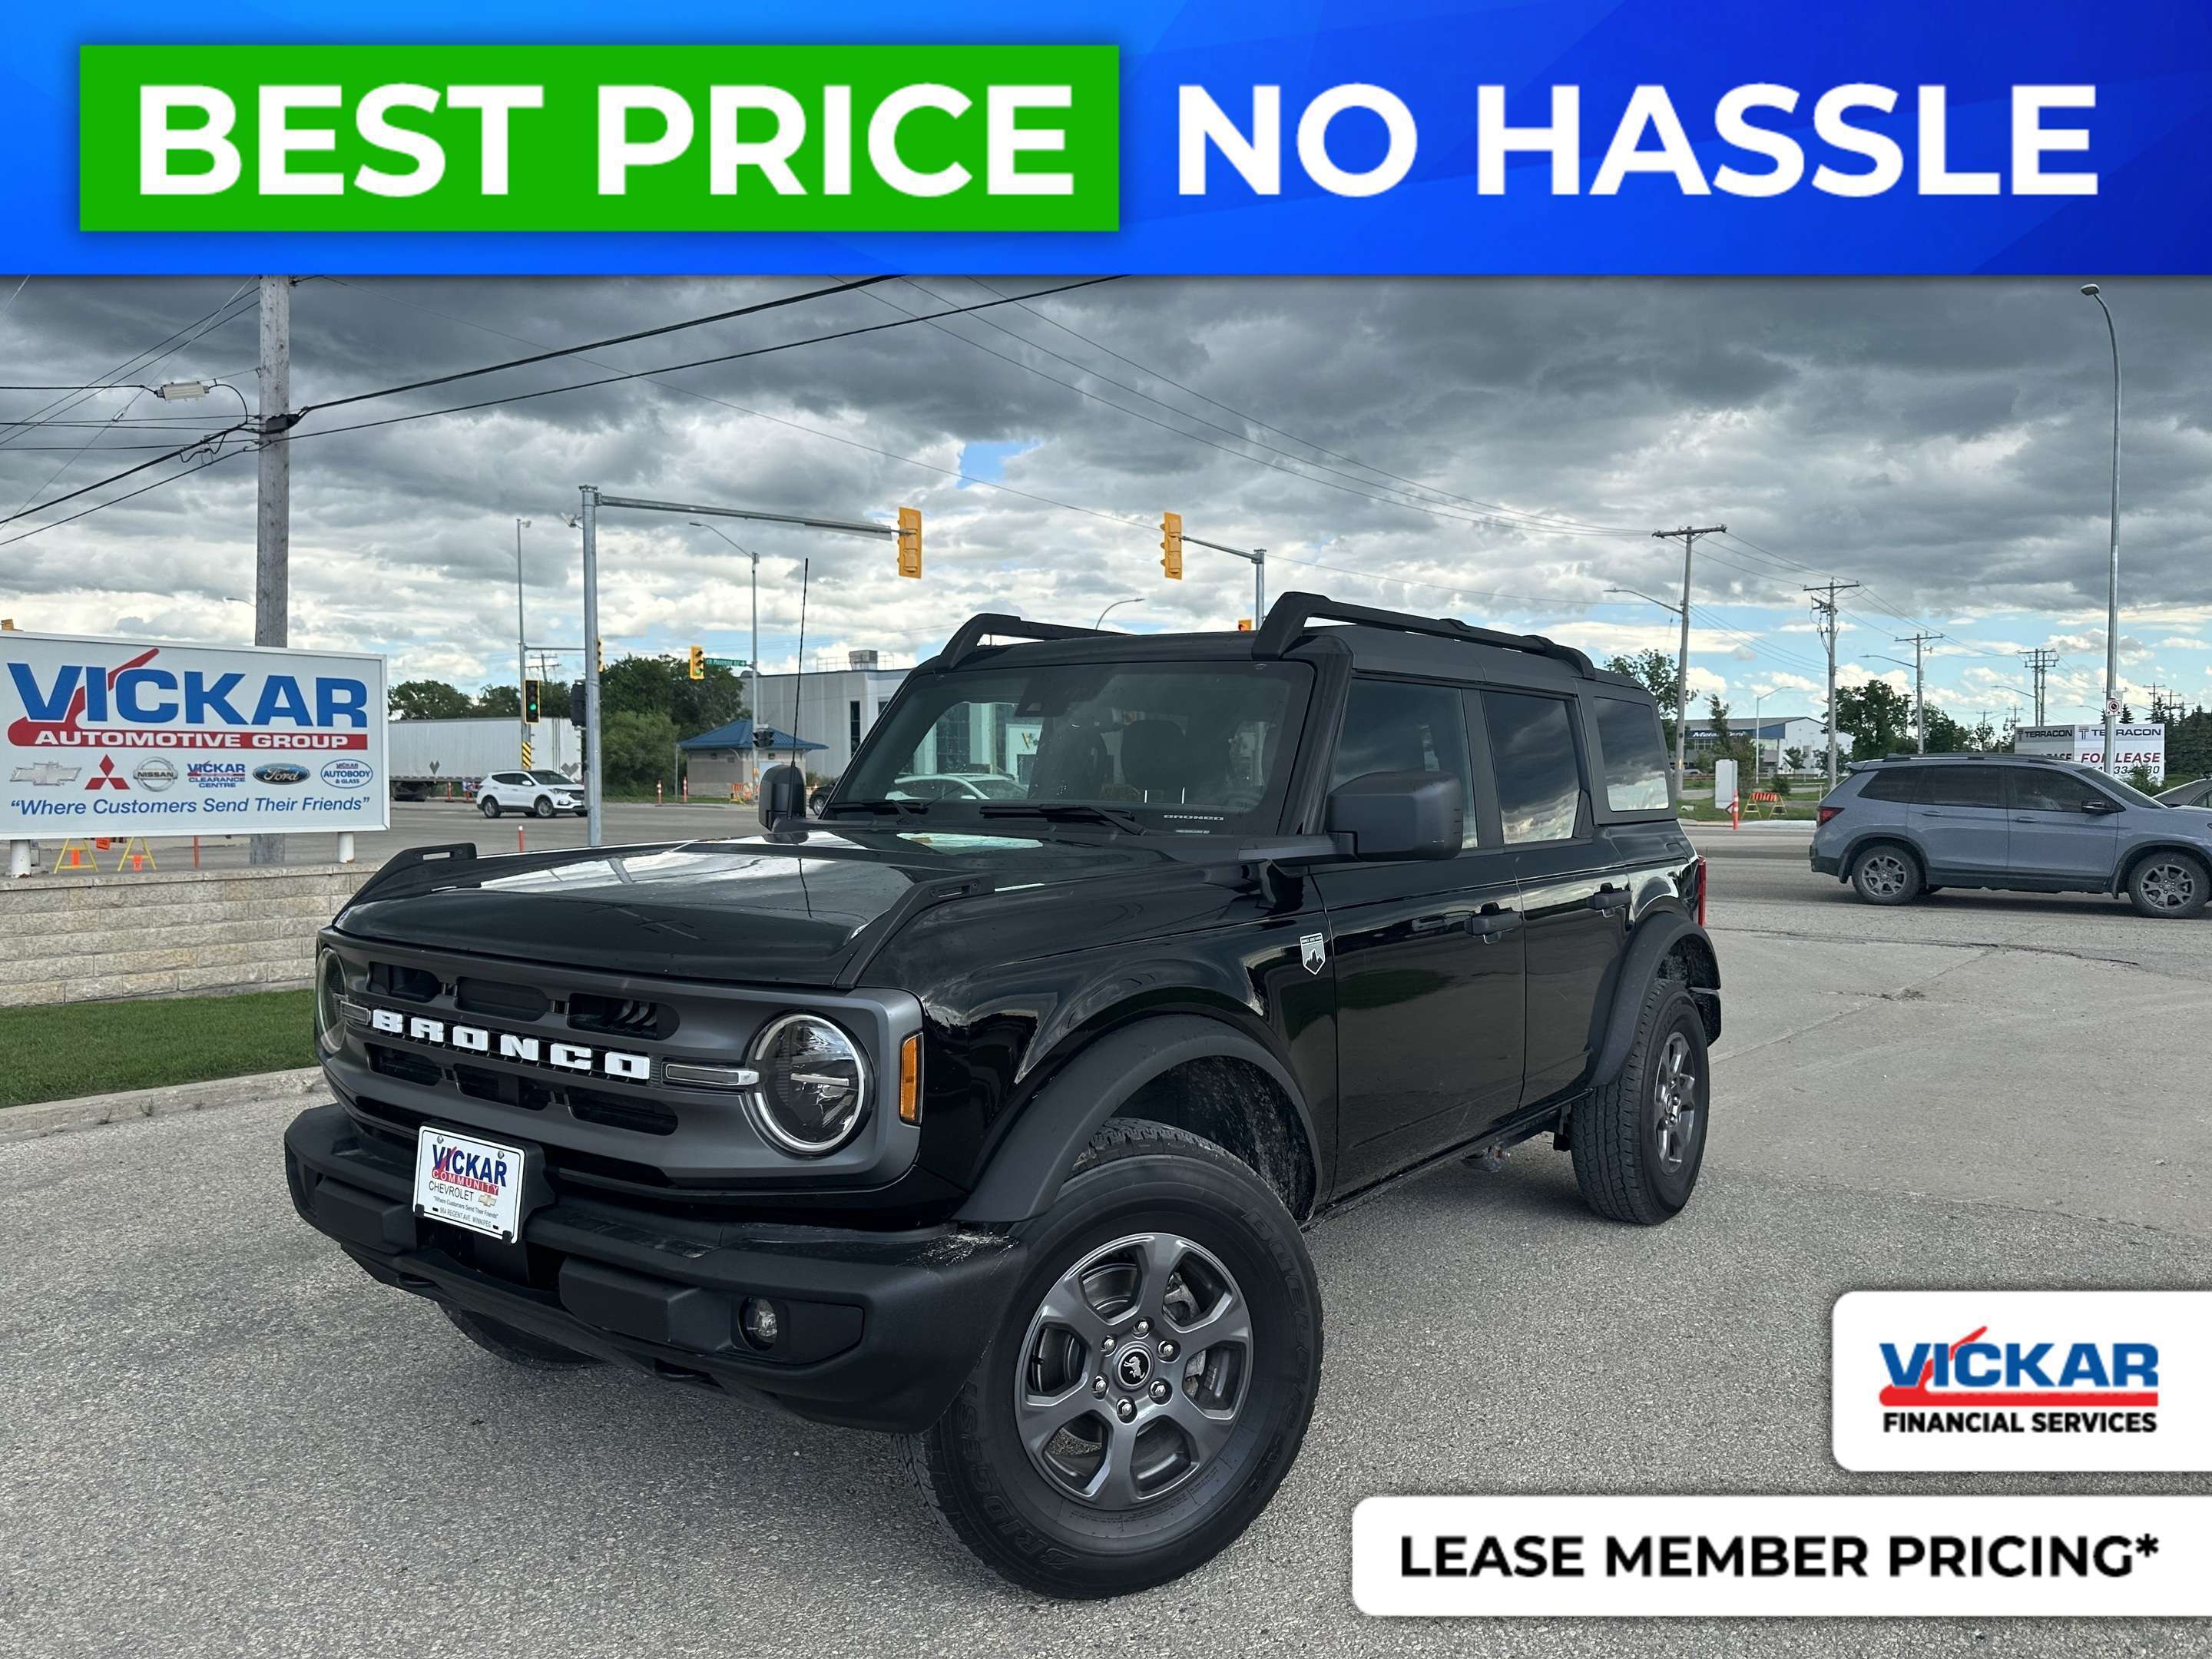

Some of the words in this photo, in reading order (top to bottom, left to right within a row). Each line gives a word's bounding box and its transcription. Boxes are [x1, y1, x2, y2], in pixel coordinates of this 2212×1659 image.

[7, 662, 369, 729] VICKAR
[35, 730, 242, 748] AUTOMOTIVE
[252, 733, 349, 749] GROUP
[2025, 730, 2072, 738] TERRACON
[187, 763, 245, 773] VICKAR
[2115, 753, 2161, 763] LEASE
[263, 768, 300, 781] Ford
[11, 799, 87, 816] “Where
[93, 799, 197, 814] Customers
[202, 798, 249, 813] Send
[254, 797, 298, 812] Their
[302, 796, 370, 811] Friends”
[373, 1008, 651, 1080] BRONCO
[432, 1144, 507, 1187] VICKAR
[429, 1181, 474, 1202] CHEVROLET
[432, 1169, 498, 1194] COMMUNITY
